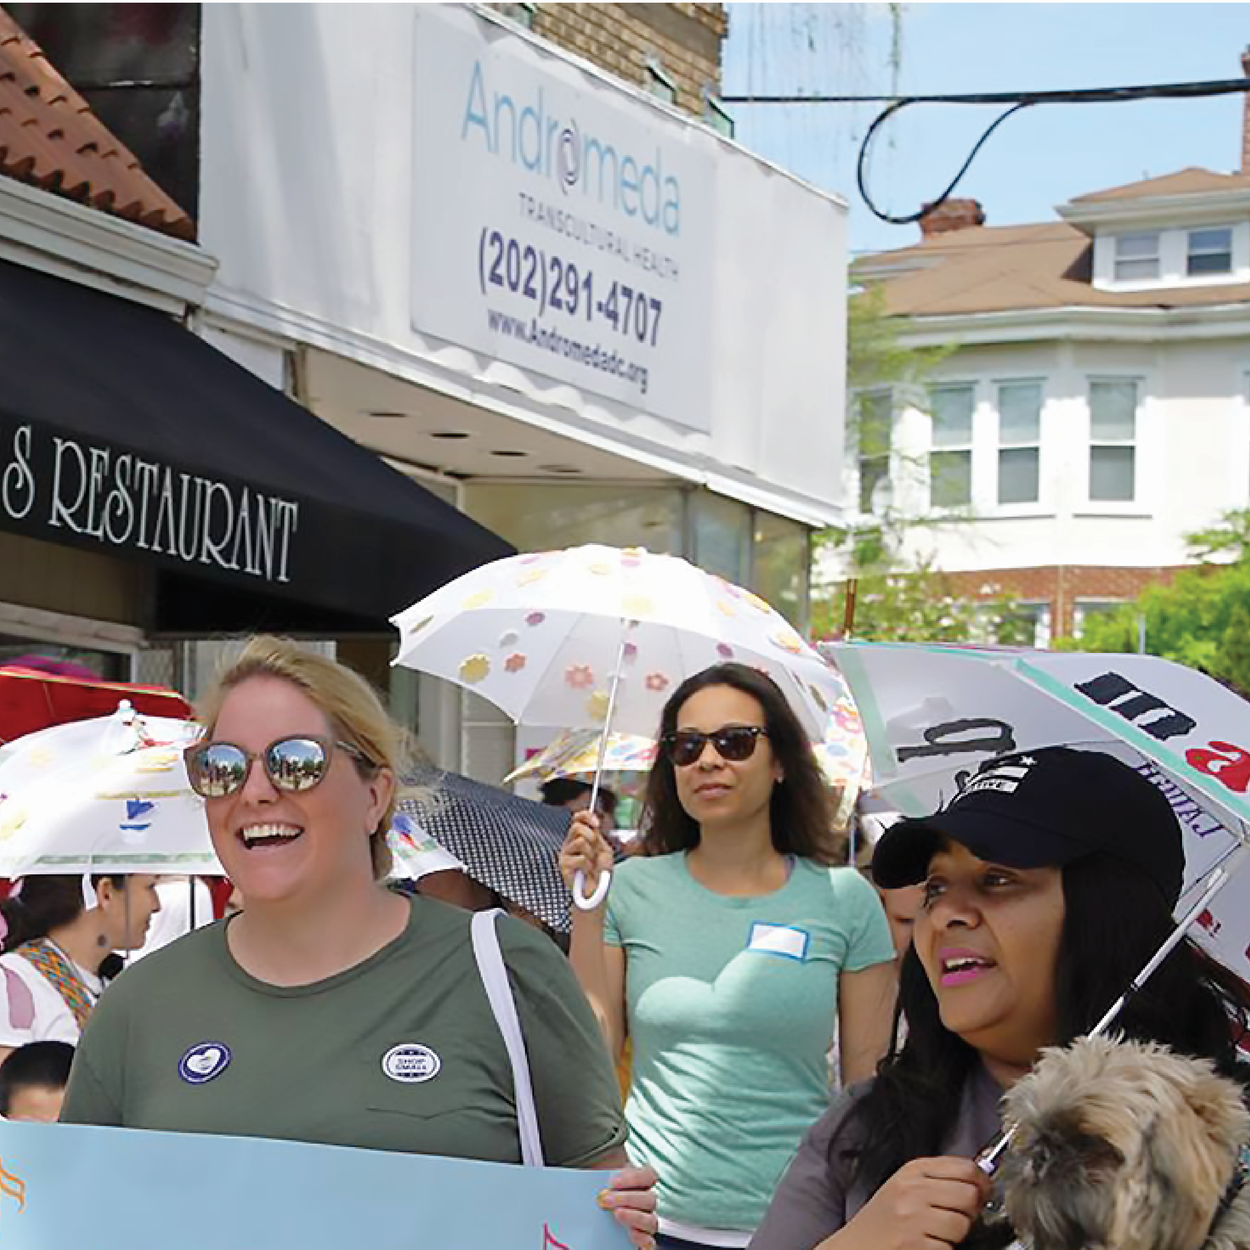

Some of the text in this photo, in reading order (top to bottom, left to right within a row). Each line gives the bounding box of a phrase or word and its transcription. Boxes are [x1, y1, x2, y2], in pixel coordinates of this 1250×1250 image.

[460, 59, 682, 238] Andromeda
[479, 227, 662, 348] (202)291-4707
[518, 193, 681, 281] TRANSCULTURAL HEALTH
[487, 308, 649, 394] www.Andromedadc.org
[48, 437, 299, 583] RESTAURANT
